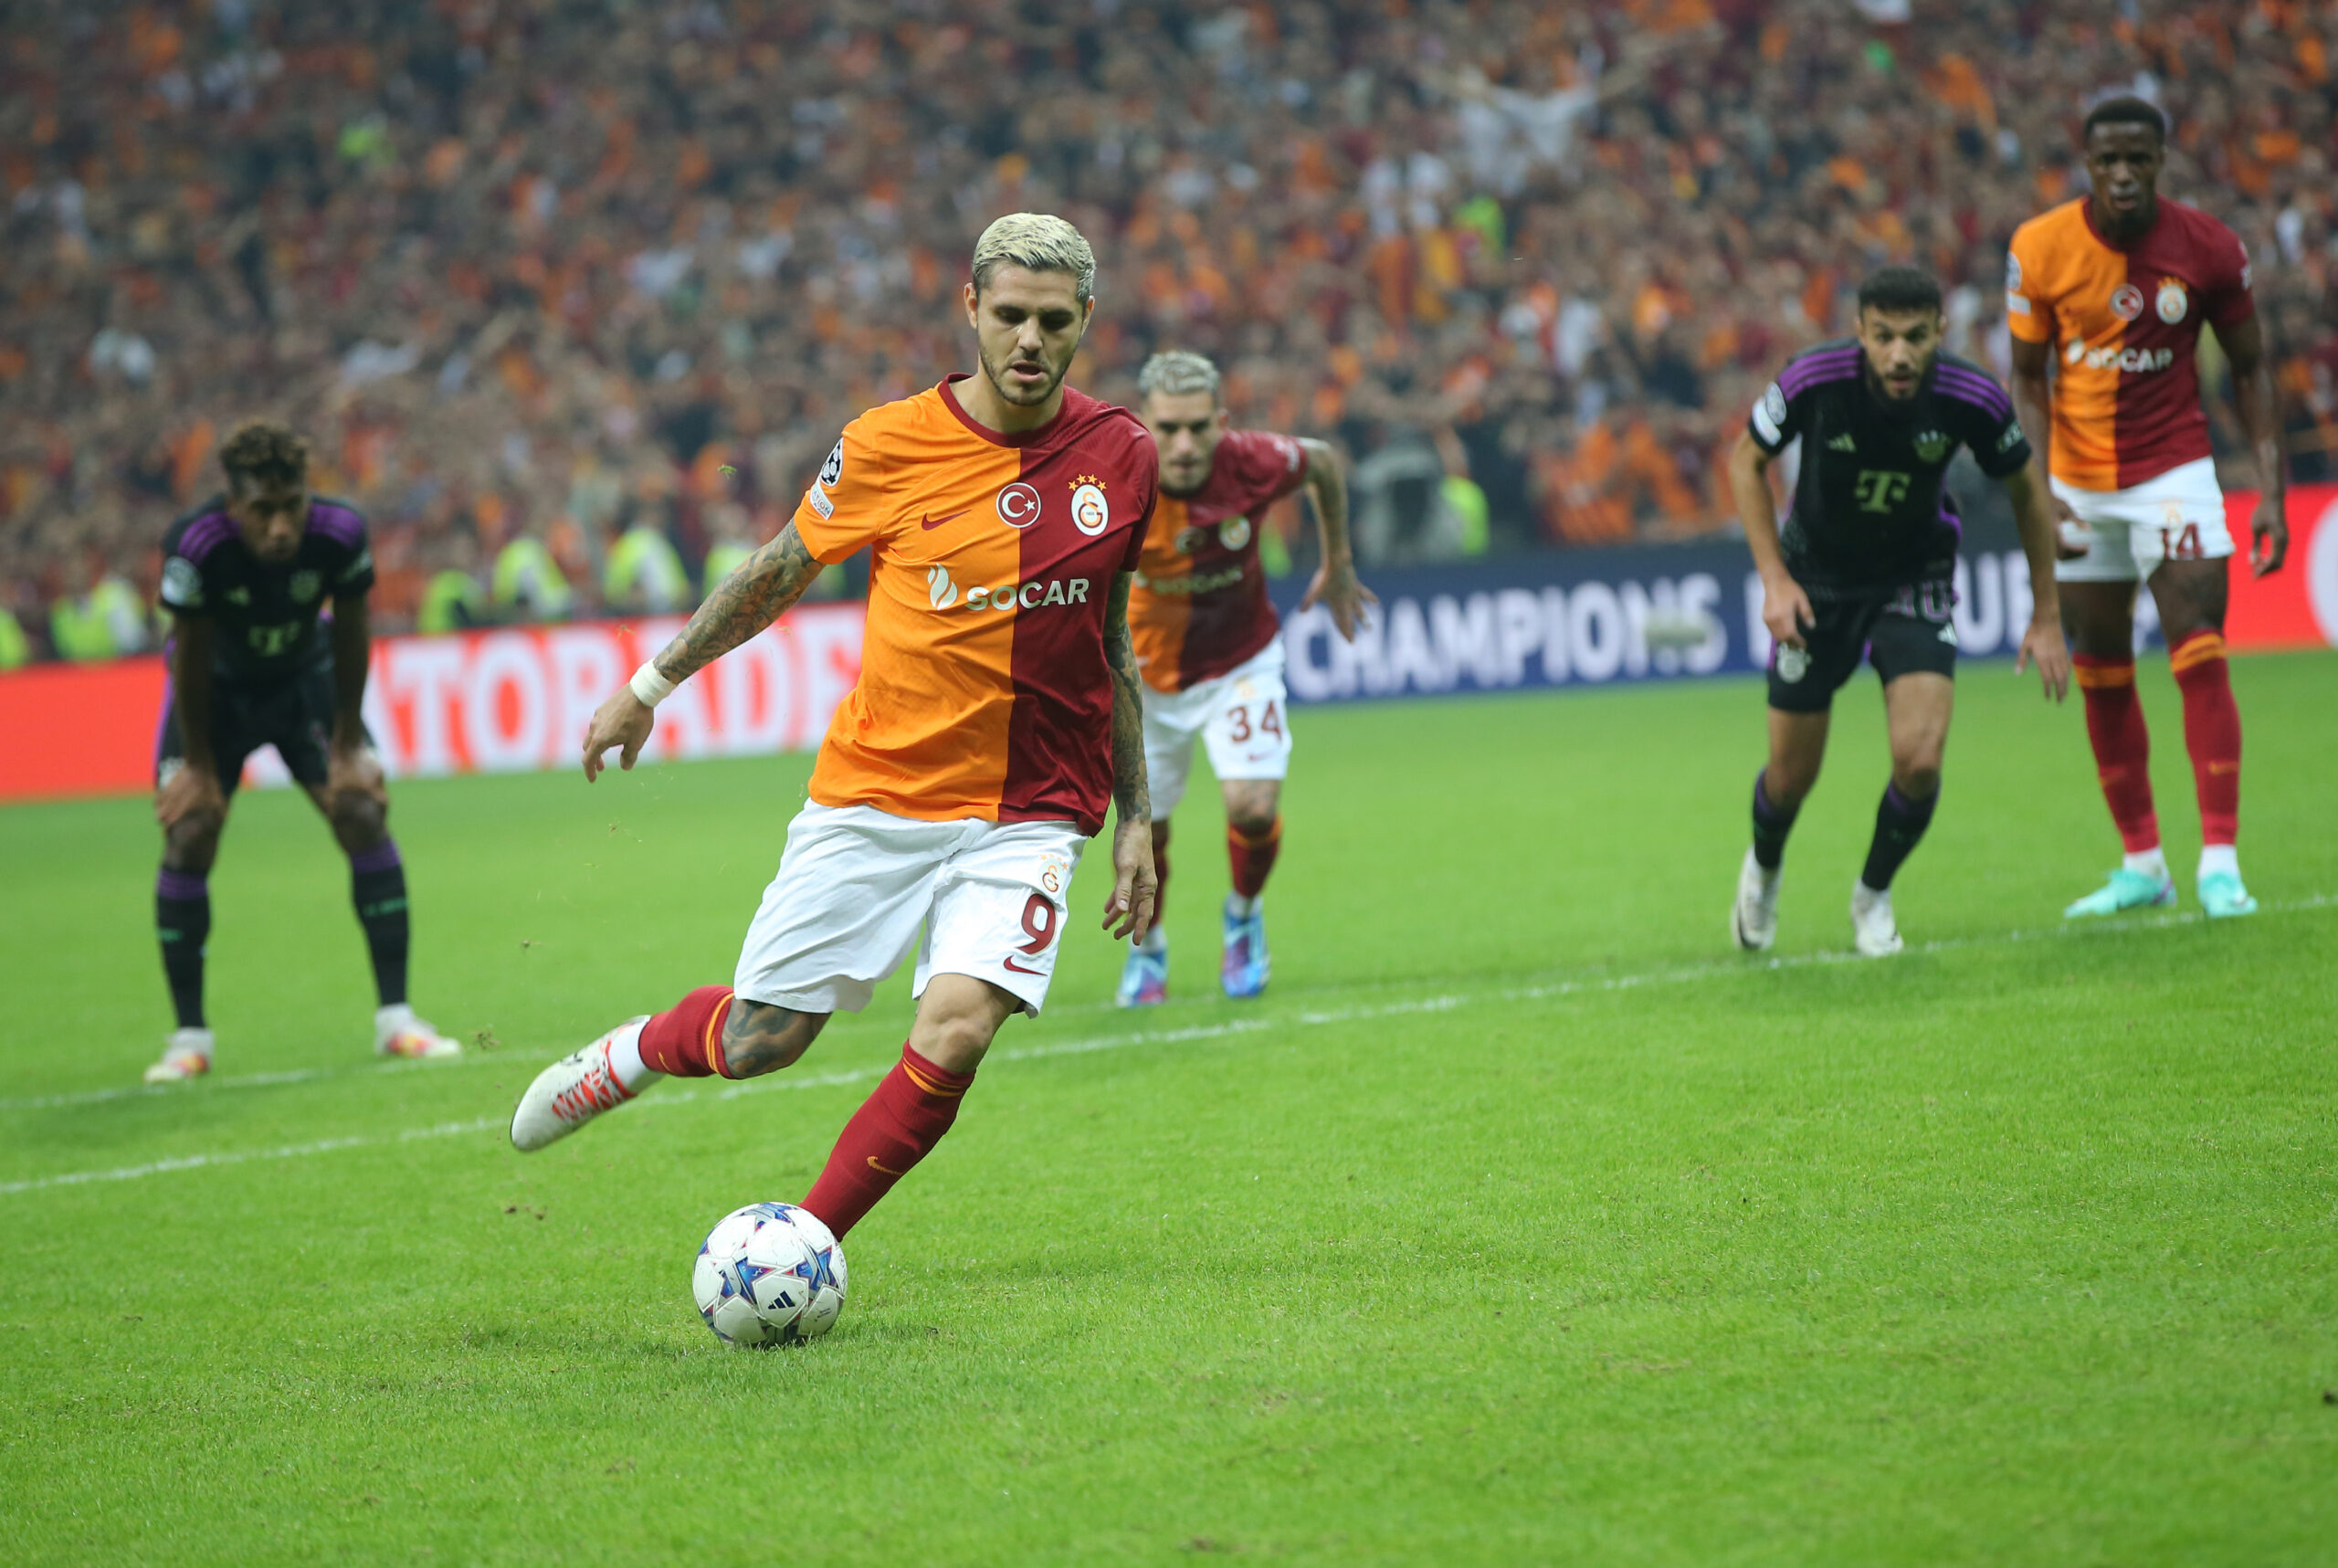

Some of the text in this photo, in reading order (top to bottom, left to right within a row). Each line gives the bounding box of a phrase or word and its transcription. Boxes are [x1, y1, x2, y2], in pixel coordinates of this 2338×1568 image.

[2160, 522, 2203, 560] 14
[965, 578, 1090, 612] SOCAR
[1281, 574, 1728, 701] CHAMPIONS
[1227, 701, 1281, 742] 34
[1016, 893, 1057, 955] 9
